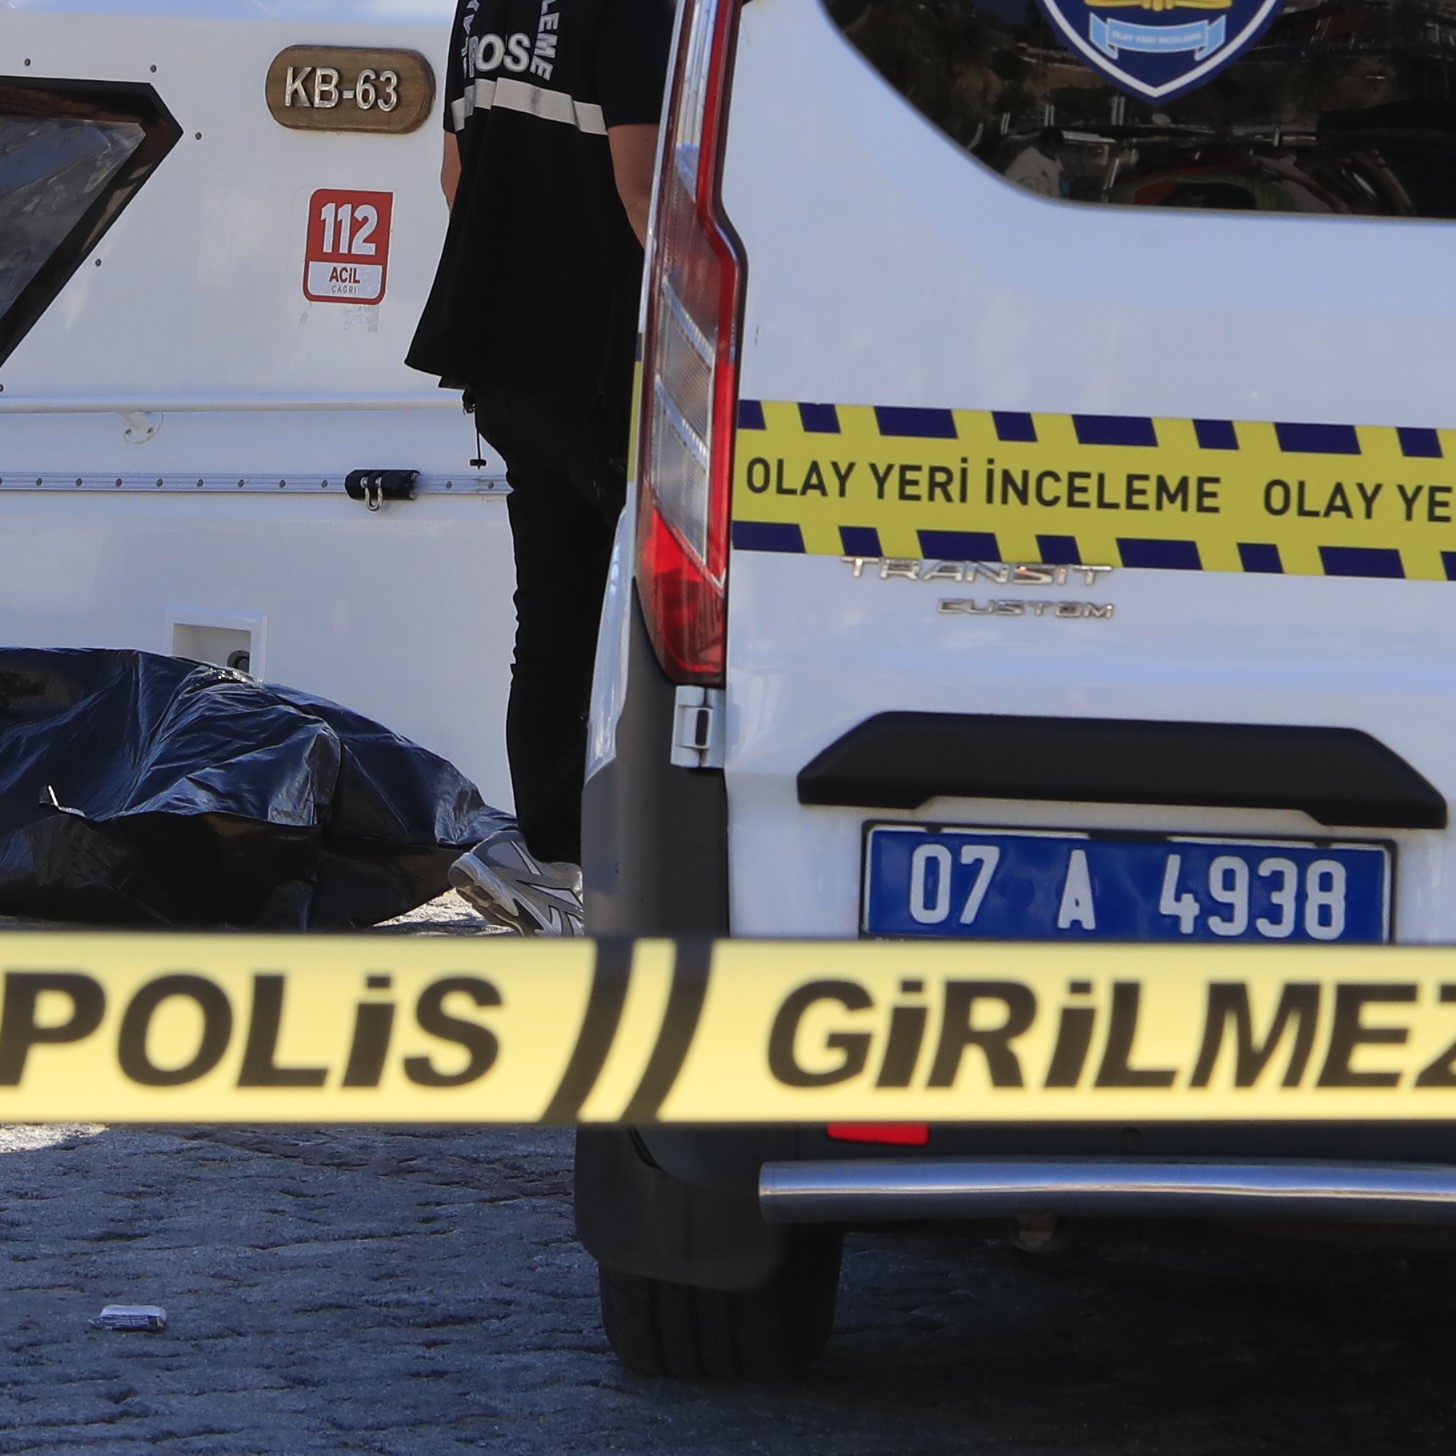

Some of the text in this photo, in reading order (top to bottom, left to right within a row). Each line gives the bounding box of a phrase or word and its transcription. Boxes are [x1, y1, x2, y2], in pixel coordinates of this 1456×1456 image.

[284, 65, 400, 112] KB-63
[319, 202, 379, 256] 112
[745, 456, 856, 499] OLAY
[869, 456, 970, 503] YERİ
[984, 457, 1223, 515] İNCELEME
[1262, 478, 1384, 521] OLAY
[841, 555, 1113, 586] TRANSIT
[936, 597, 1114, 619] CUSTOM
[908, 844, 1347, 939] 07 A 4938
